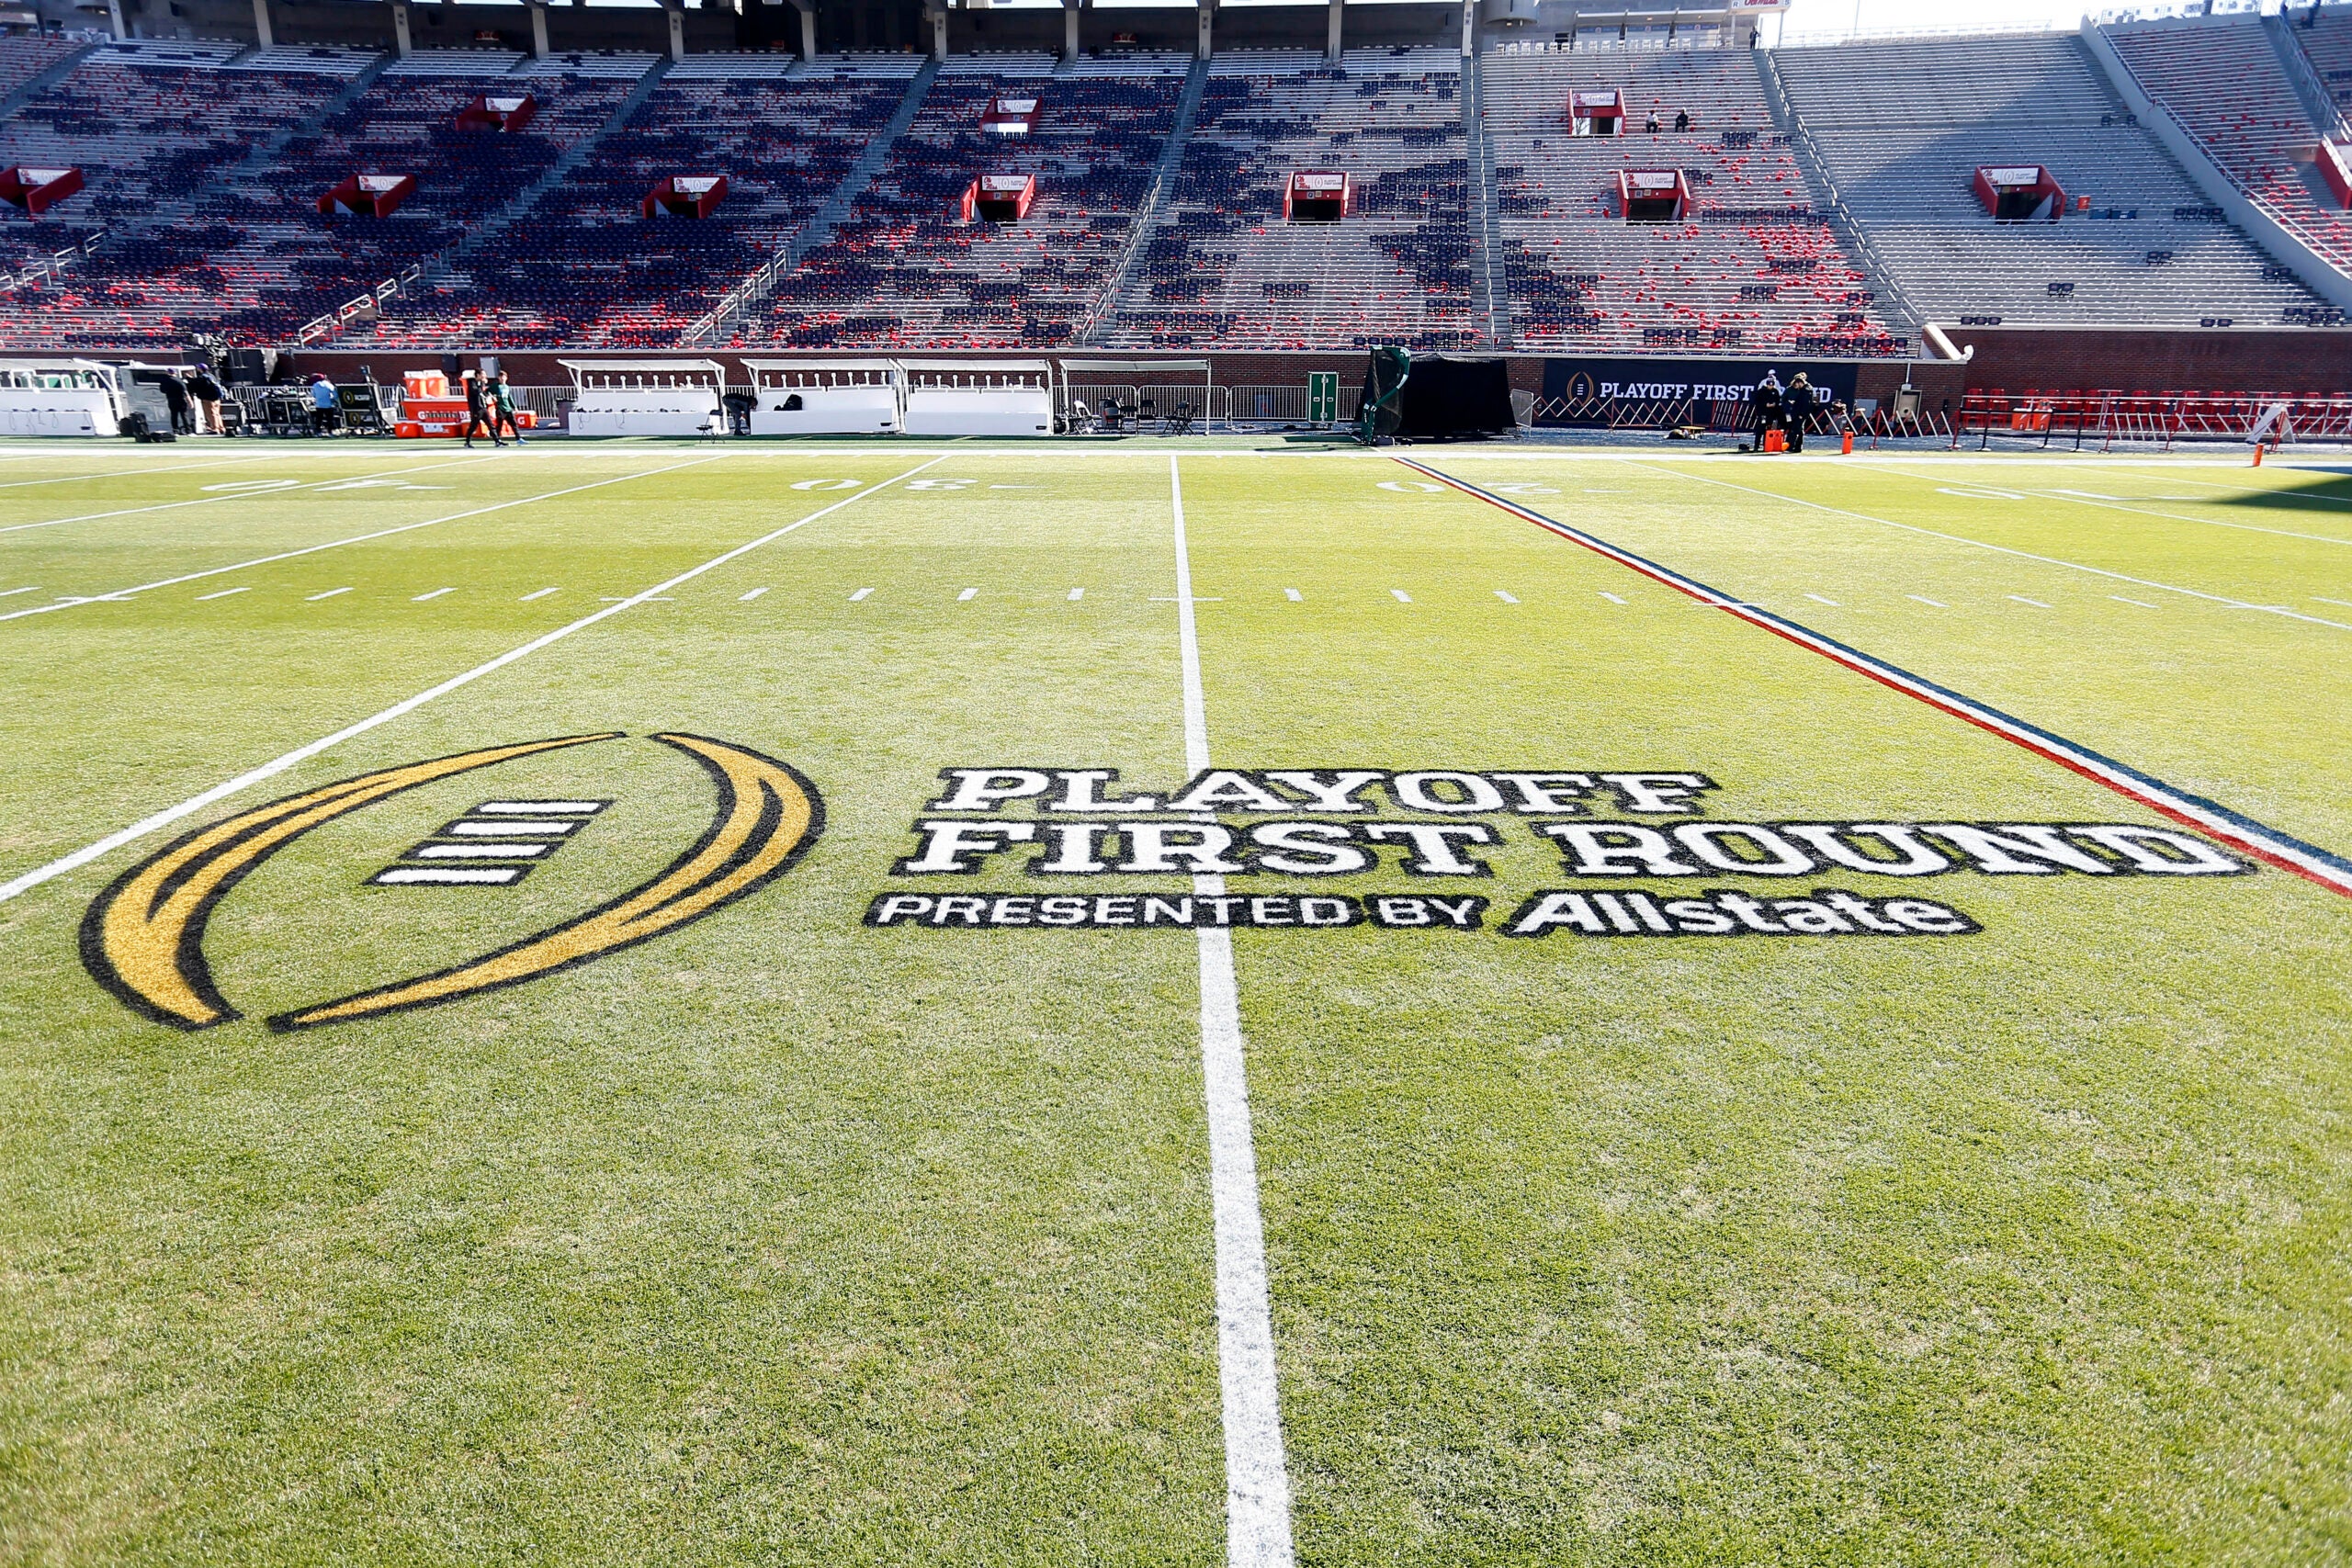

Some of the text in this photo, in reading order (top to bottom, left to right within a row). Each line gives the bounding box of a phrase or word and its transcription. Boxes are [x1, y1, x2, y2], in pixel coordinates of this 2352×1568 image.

[1600, 382, 1688, 400] PLAYOFF
[1692, 384, 1754, 401] FIRST
[517, 416, 526, 425] G
[932, 769, 1714, 815] PLAYOFF
[898, 820, 2249, 875] FIRST ROUND
[874, 891, 1974, 935] PRESENTED BY Allstate
